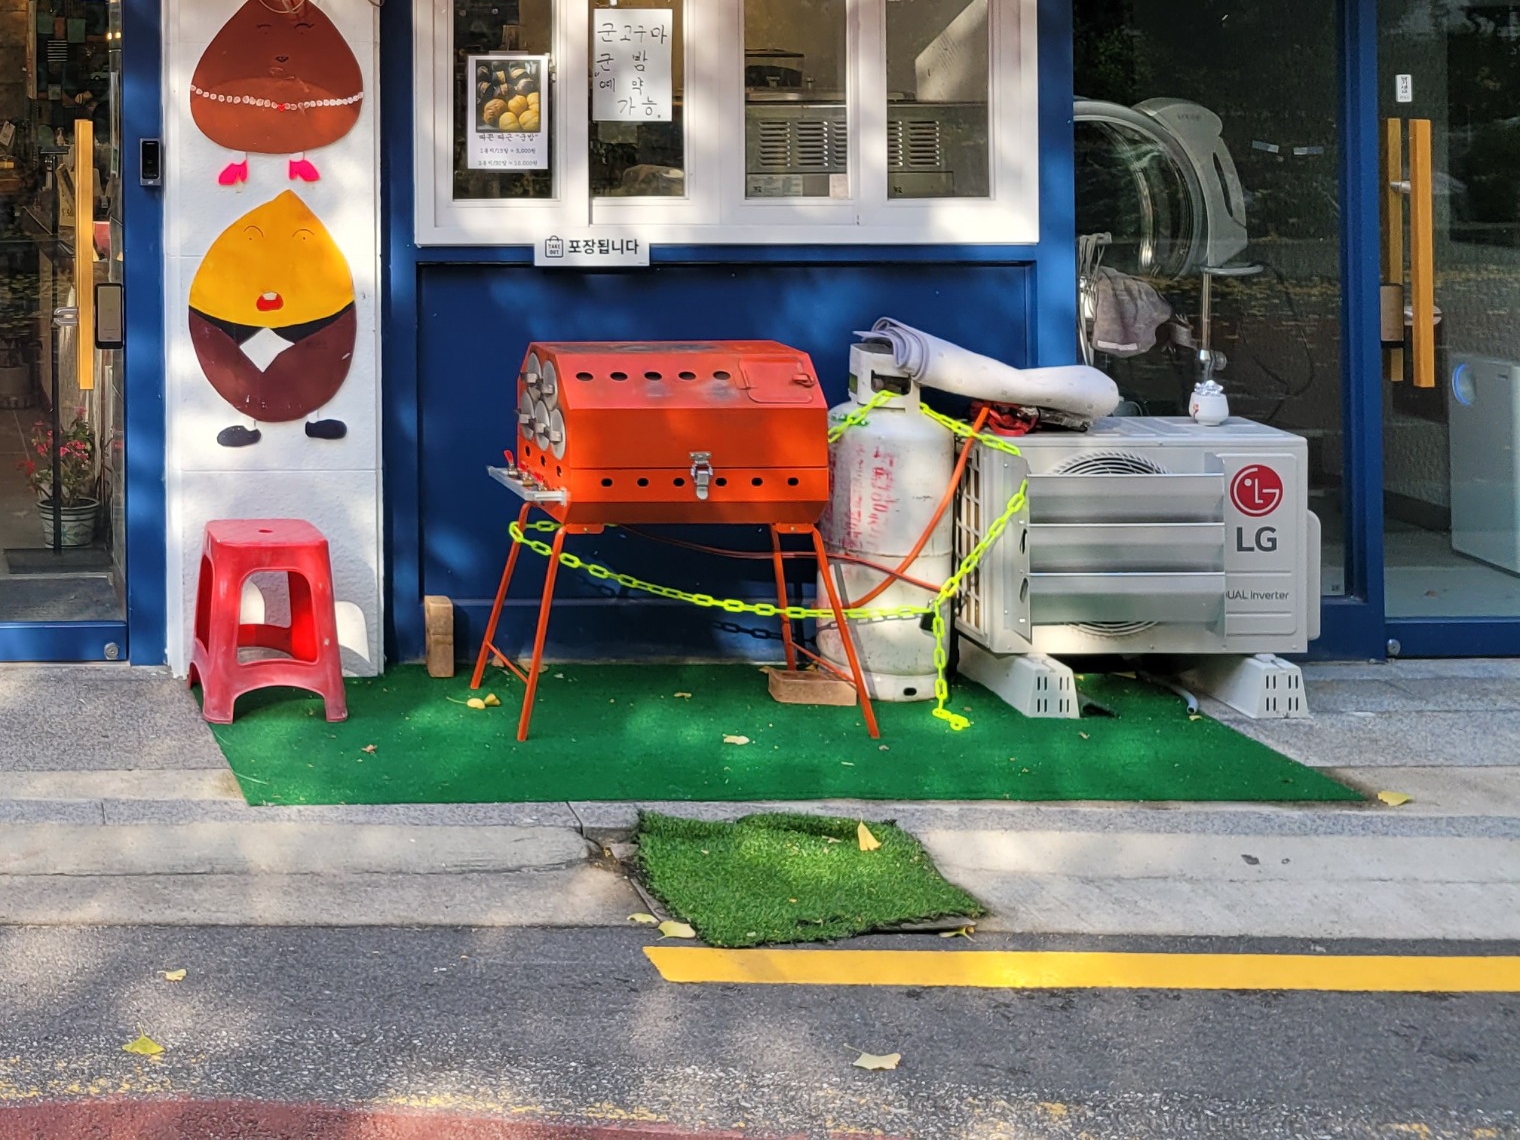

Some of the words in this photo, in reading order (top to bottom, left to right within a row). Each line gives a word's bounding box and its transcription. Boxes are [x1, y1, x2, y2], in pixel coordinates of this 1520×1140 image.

[596, 22, 668, 45] 군고구마
[568, 238, 640, 255] 포장됩니다
[1235, 526, 1278, 552] LG
[1225, 589, 1248, 600] UAL
[1250, 589, 1290, 600] Inverter
